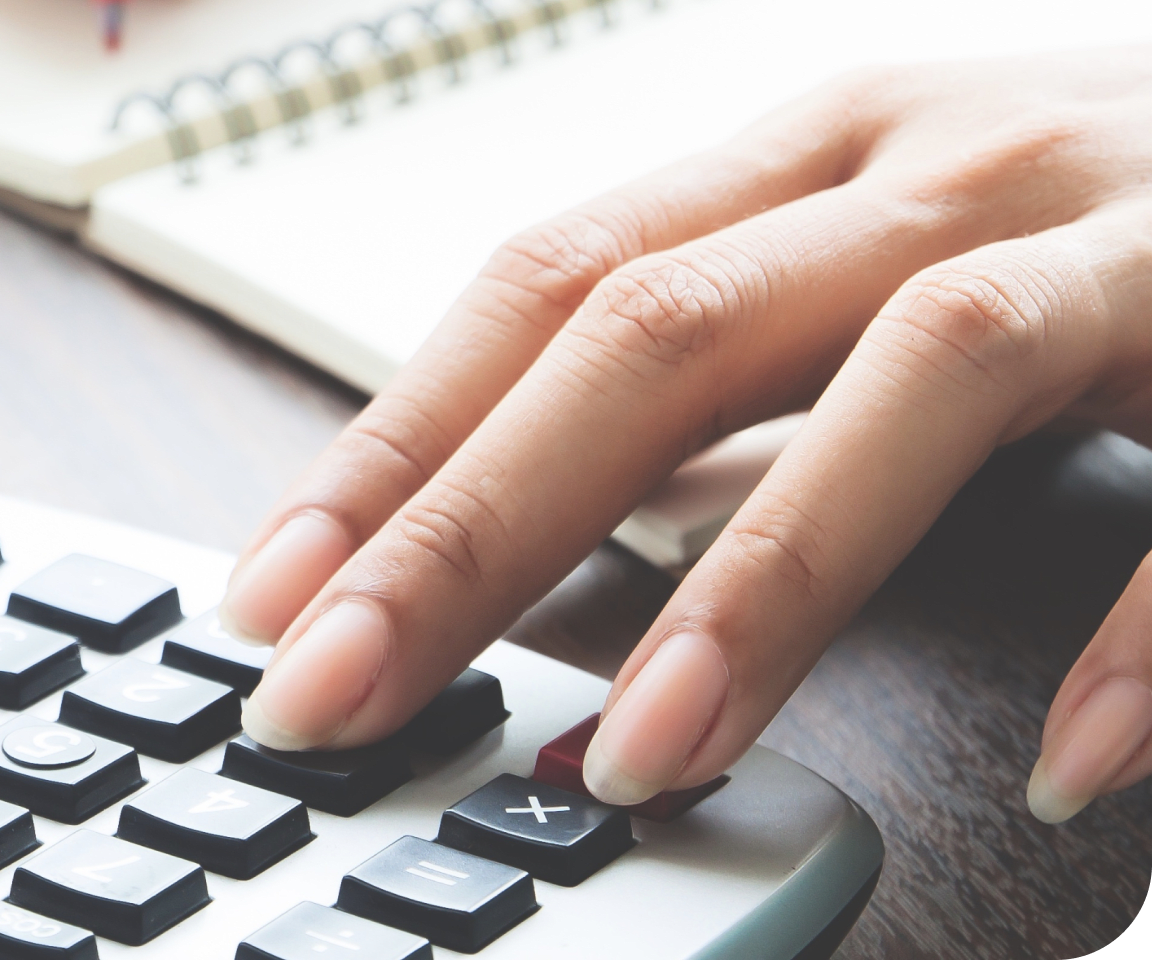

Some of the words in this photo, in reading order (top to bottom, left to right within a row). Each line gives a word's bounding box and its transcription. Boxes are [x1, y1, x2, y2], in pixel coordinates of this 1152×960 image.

[122, 672, 192, 703] 2
[15, 731, 81, 758] 5
[188, 790, 249, 814] 4
[71, 855, 141, 883] 7
